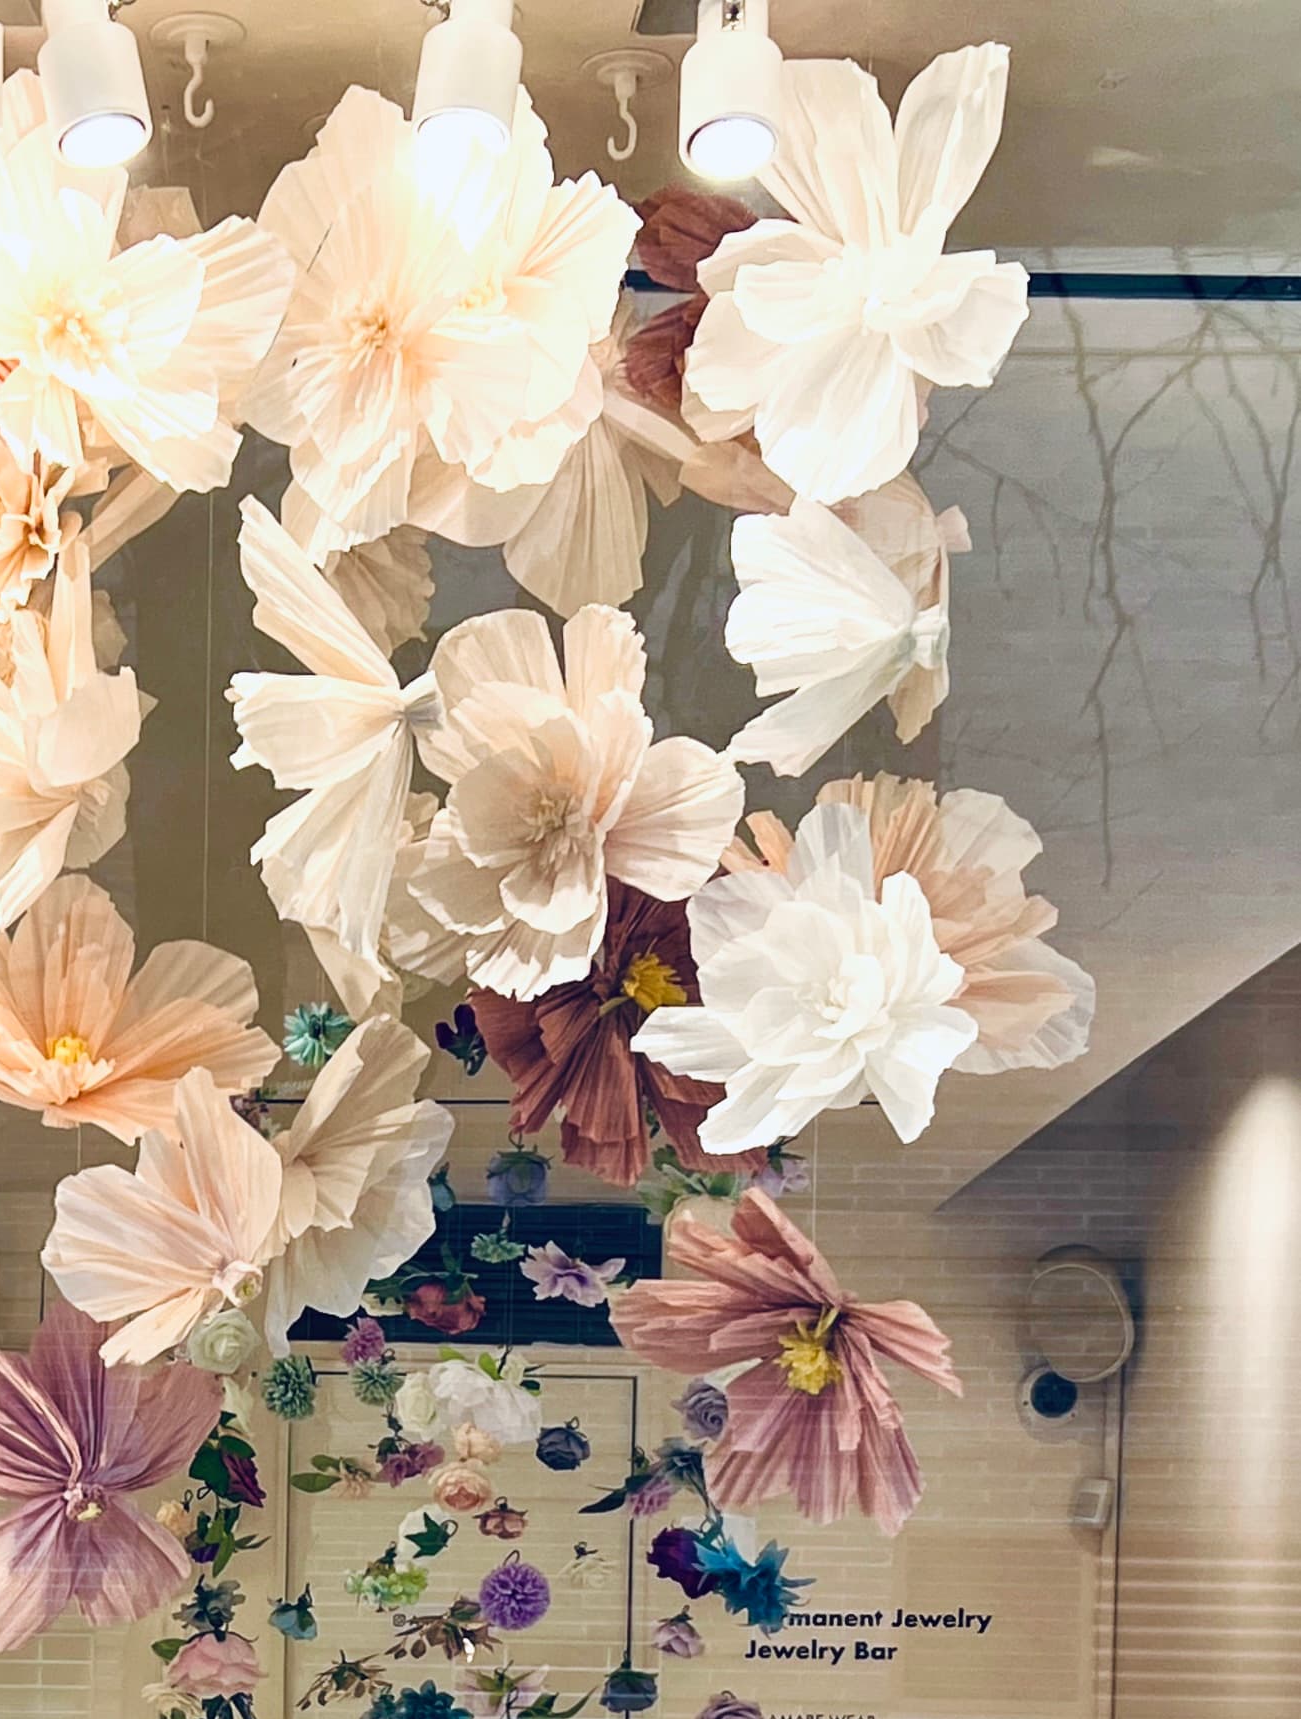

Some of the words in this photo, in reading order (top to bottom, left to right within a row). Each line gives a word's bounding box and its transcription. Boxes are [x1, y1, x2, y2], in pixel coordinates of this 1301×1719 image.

[891, 1607, 992, 1633] Jewelry
[744, 1639, 846, 1665] Jewelry
[853, 1640, 898, 1660] Bar
